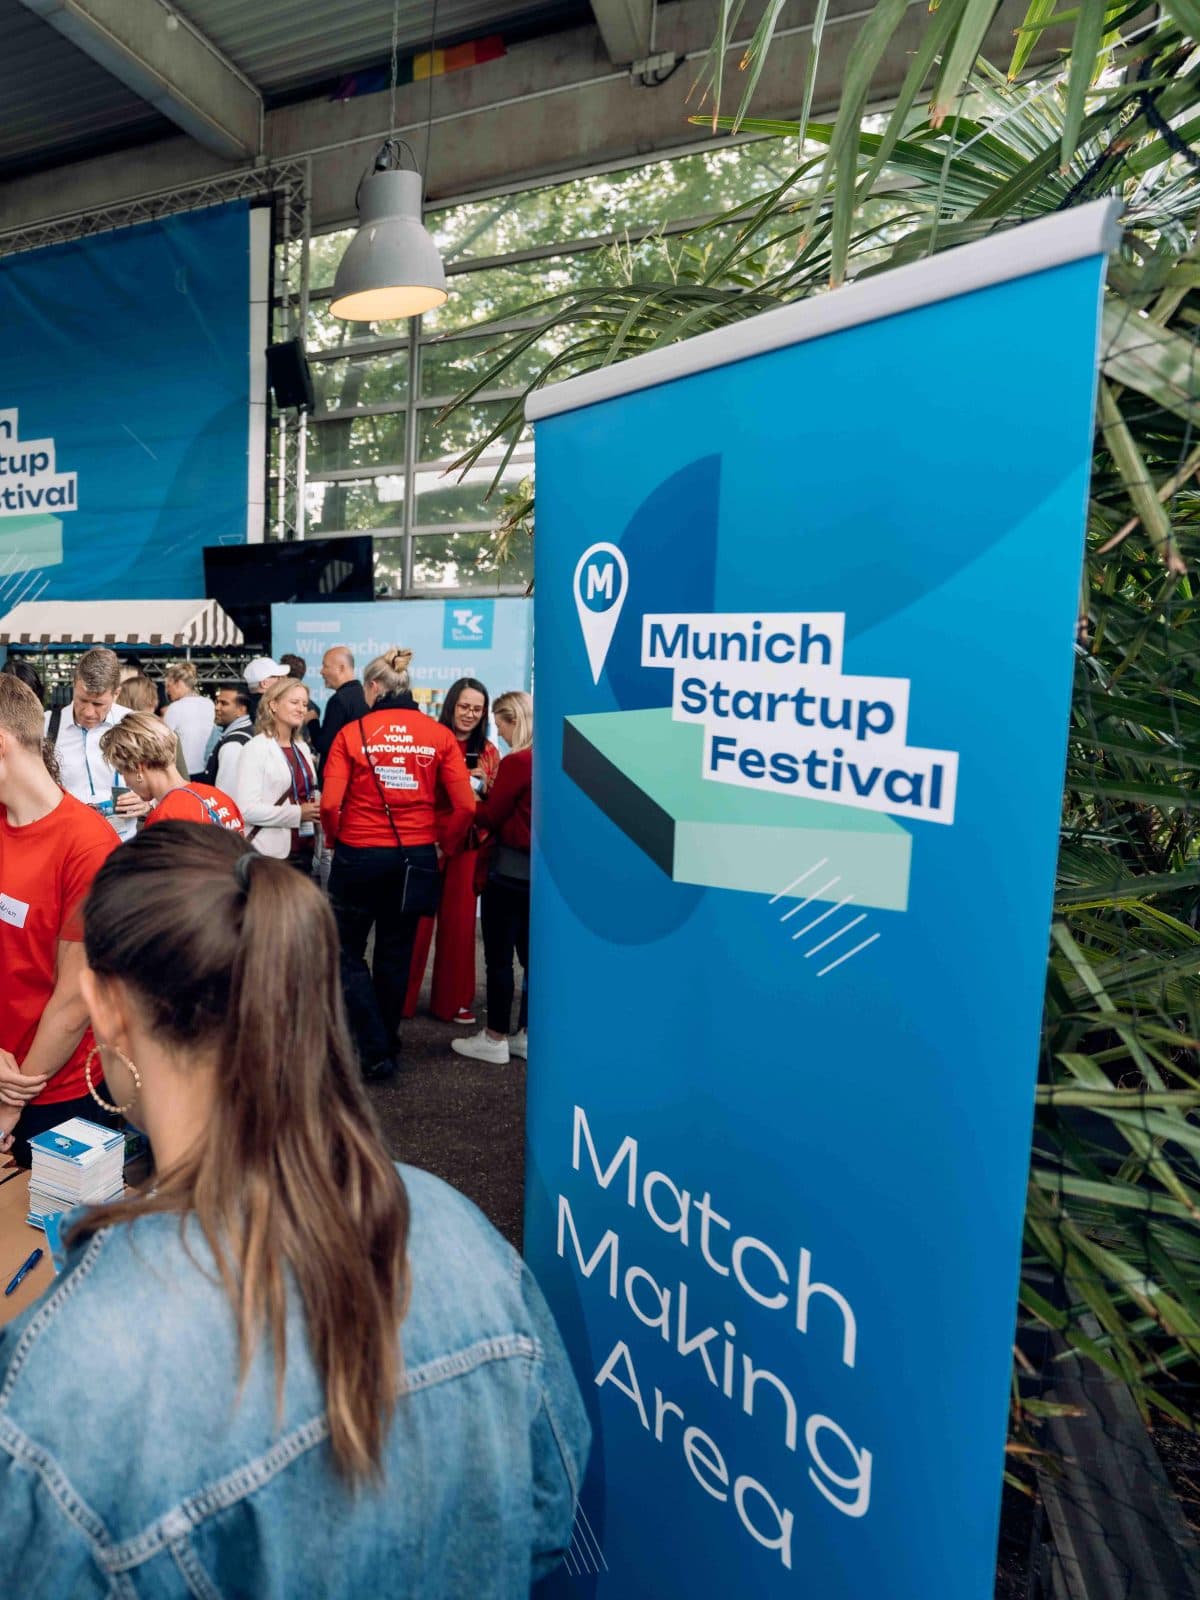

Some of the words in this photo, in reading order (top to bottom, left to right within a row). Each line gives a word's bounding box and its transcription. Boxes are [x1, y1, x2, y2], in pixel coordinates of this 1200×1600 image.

[586, 563, 614, 600] M
[296, 639, 325, 654] Wir
[453, 609, 483, 634] TK
[648, 620, 832, 665] Munich
[680, 676, 895, 741] Startup
[383, 734, 414, 743] YOUR
[710, 735, 944, 810] Festival
[572, 1104, 857, 1369] Match
[556, 1193, 873, 1519] Making
[593, 1339, 795, 1570] Area
